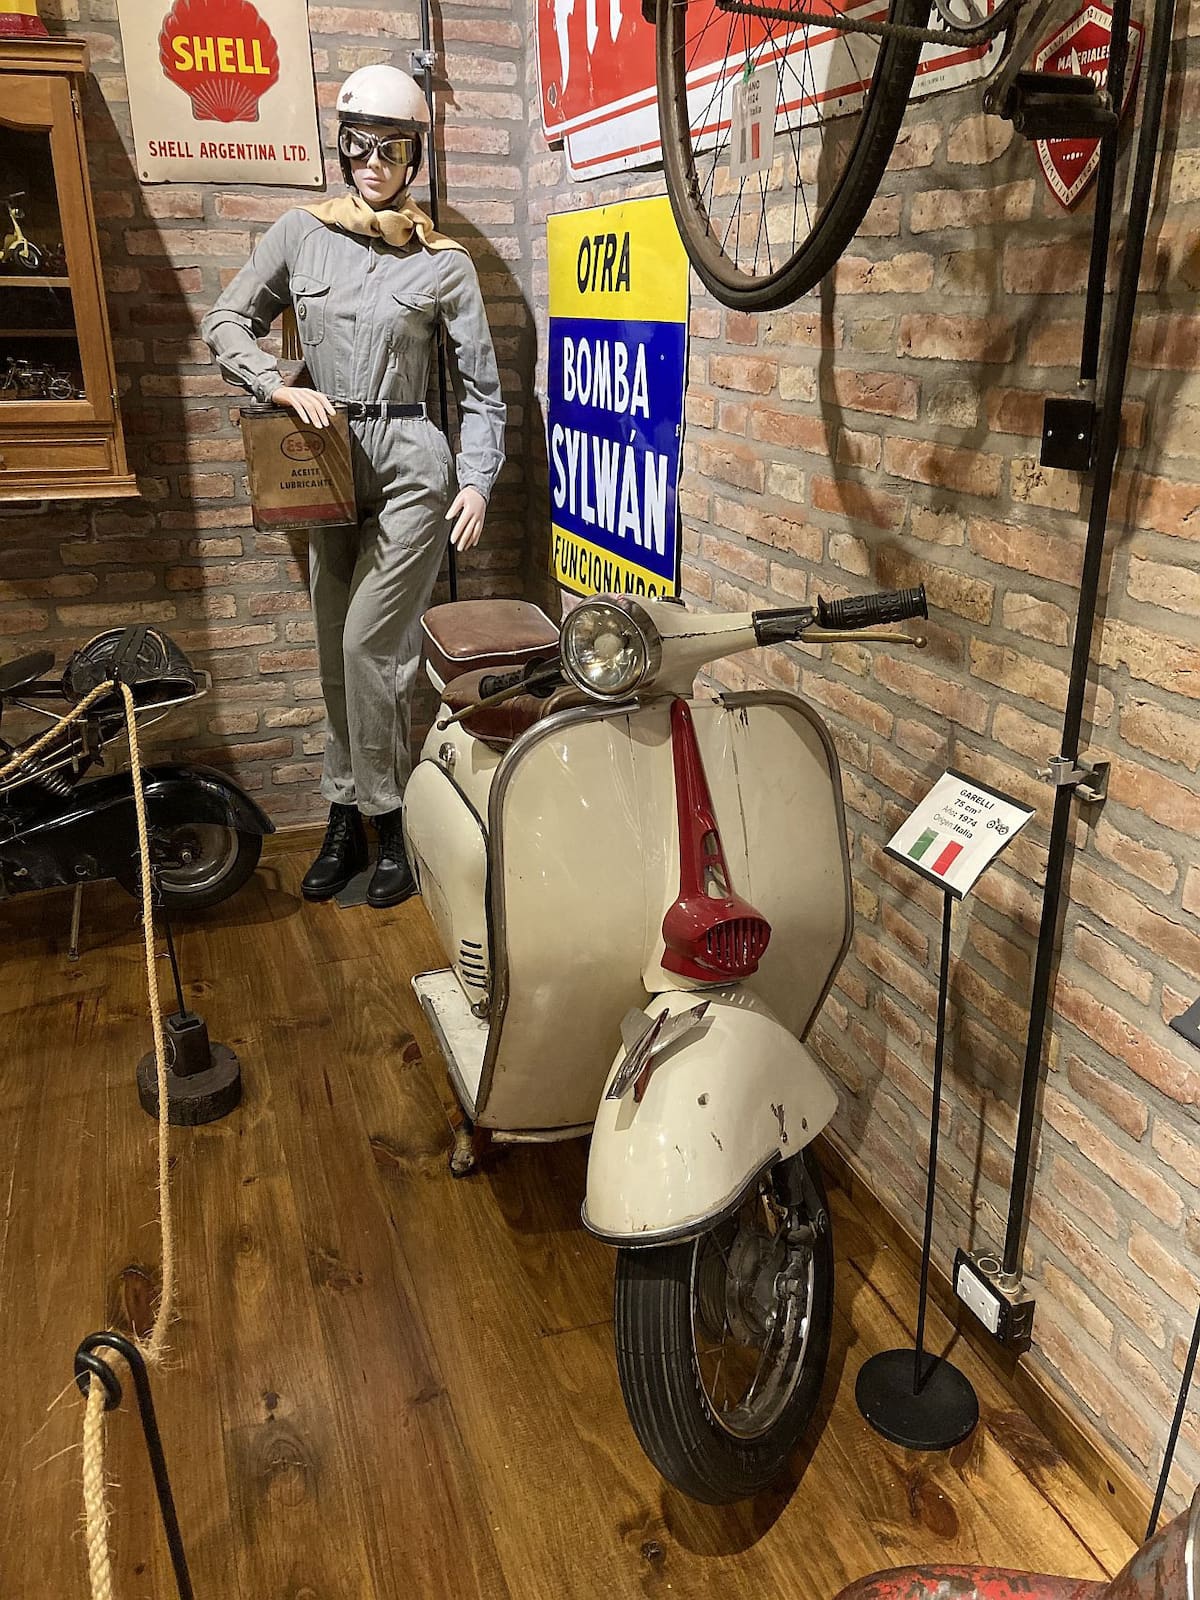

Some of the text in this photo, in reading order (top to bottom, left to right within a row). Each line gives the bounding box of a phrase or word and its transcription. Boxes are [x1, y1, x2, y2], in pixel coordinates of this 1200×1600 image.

[171, 35, 271, 75] SHELL
[1057, 44, 1111, 71] MAERIALES
[149, 140, 310, 162] SHELL ARGENTINA LTD.
[576, 231, 631, 294] OTRA
[563, 336, 650, 419] BOMBA
[551, 423, 668, 556] SYLWÁN
[954, 798, 966, 808] 75
[960, 789, 995, 810] GARELLI
[952, 824, 974, 839] Italia
[958, 814, 978, 827] 1974
